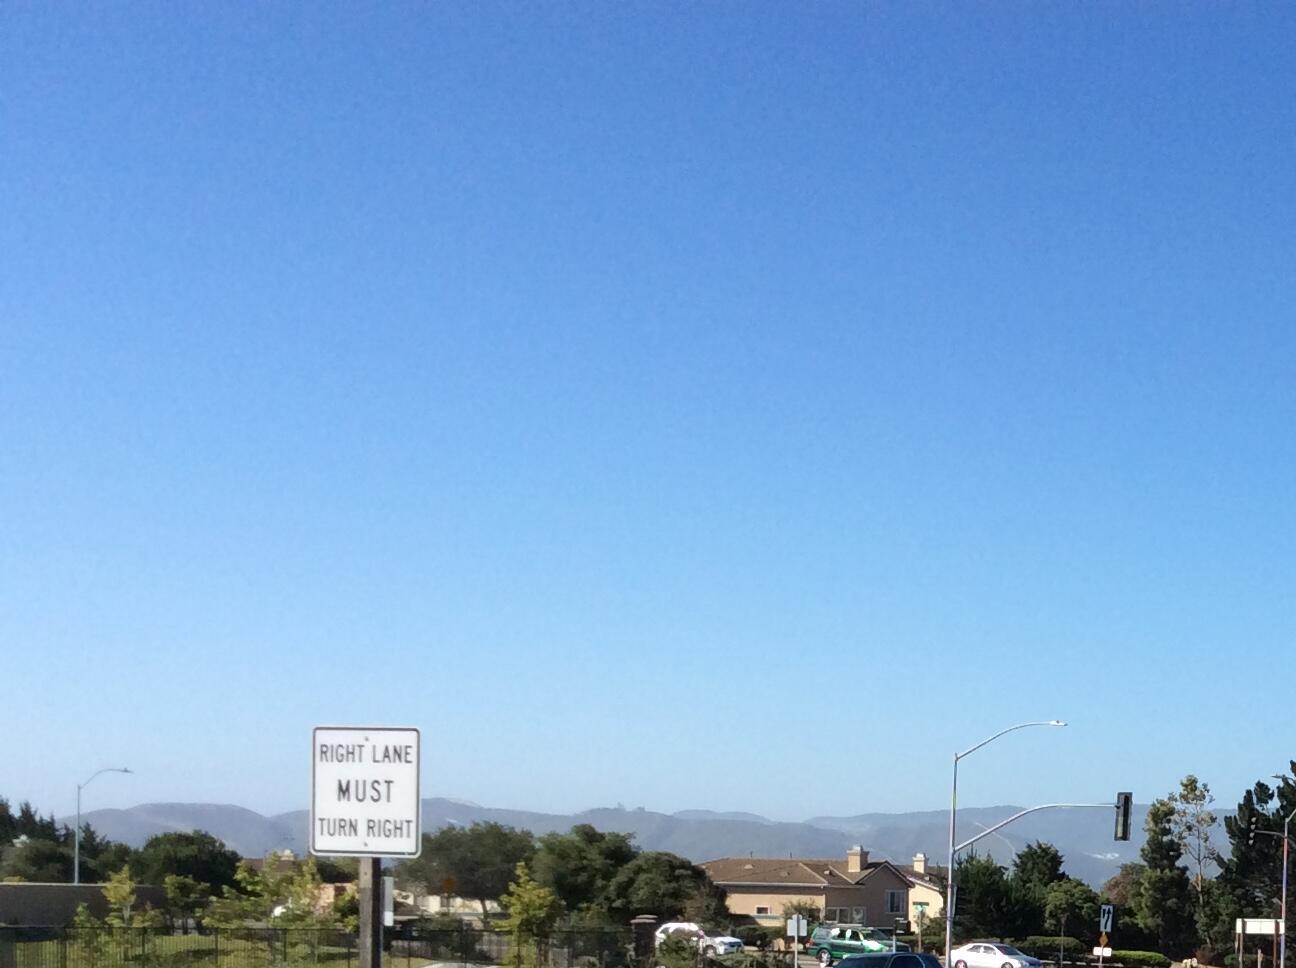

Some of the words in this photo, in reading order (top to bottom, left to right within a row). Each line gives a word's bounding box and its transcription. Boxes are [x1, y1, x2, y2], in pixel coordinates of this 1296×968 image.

[319, 743, 365, 763] RIGHT
[372, 744, 413, 764] LANE
[337, 778, 394, 803] MUST
[318, 817, 358, 837] TURN
[366, 818, 413, 839] RIGHT
